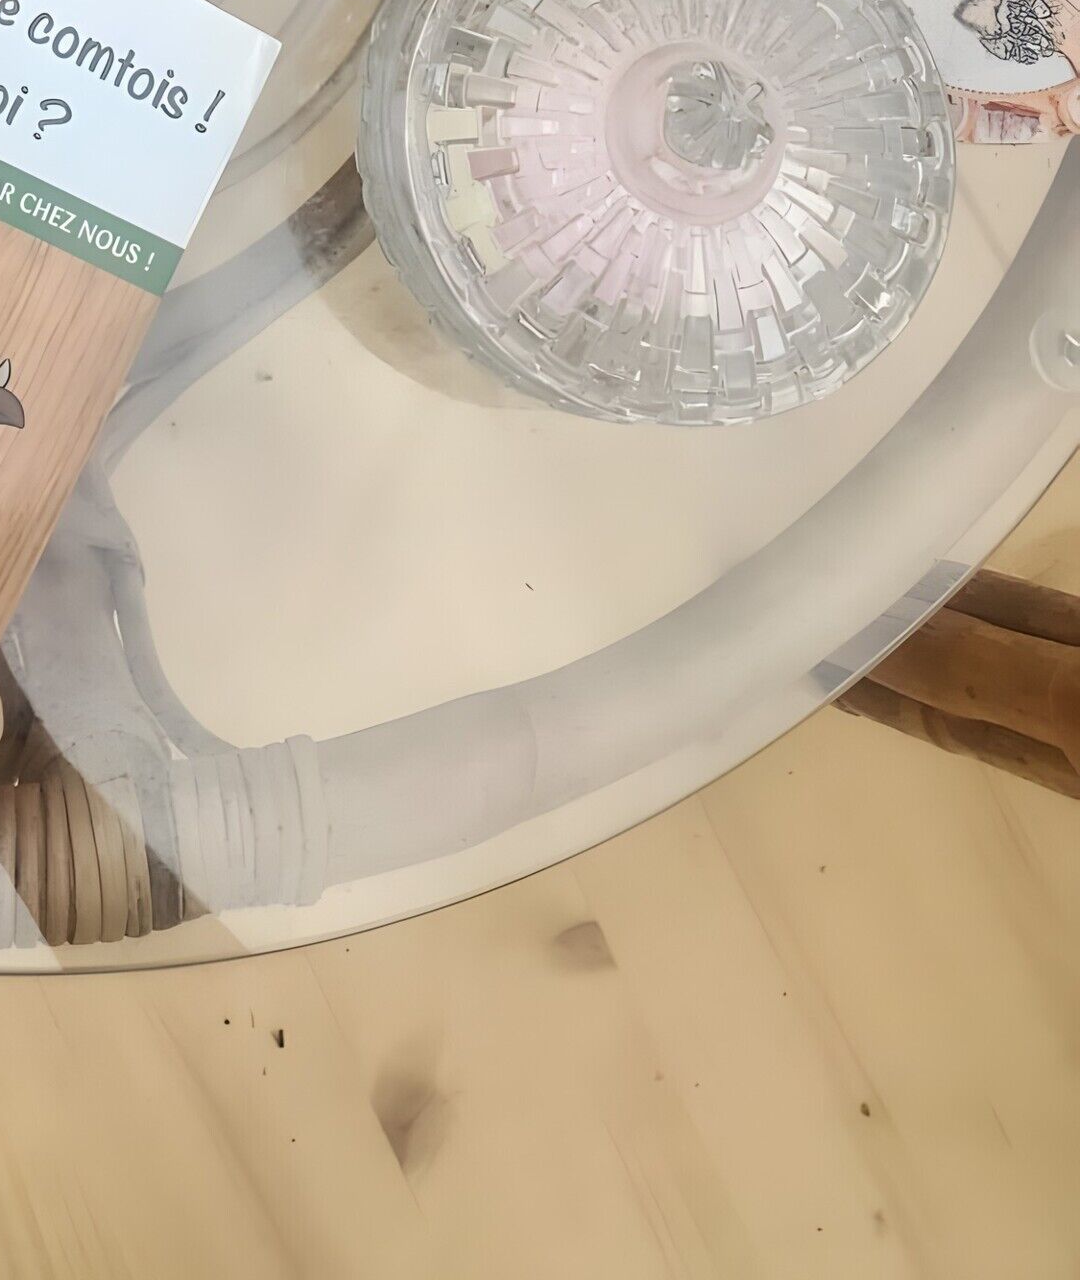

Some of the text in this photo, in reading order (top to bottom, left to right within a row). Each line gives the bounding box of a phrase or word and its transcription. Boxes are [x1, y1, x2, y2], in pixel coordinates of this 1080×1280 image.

[28, 12, 188, 120] comtois
[19, 192, 77, 234] CHEZ
[77, 219, 141, 264] NOUS
